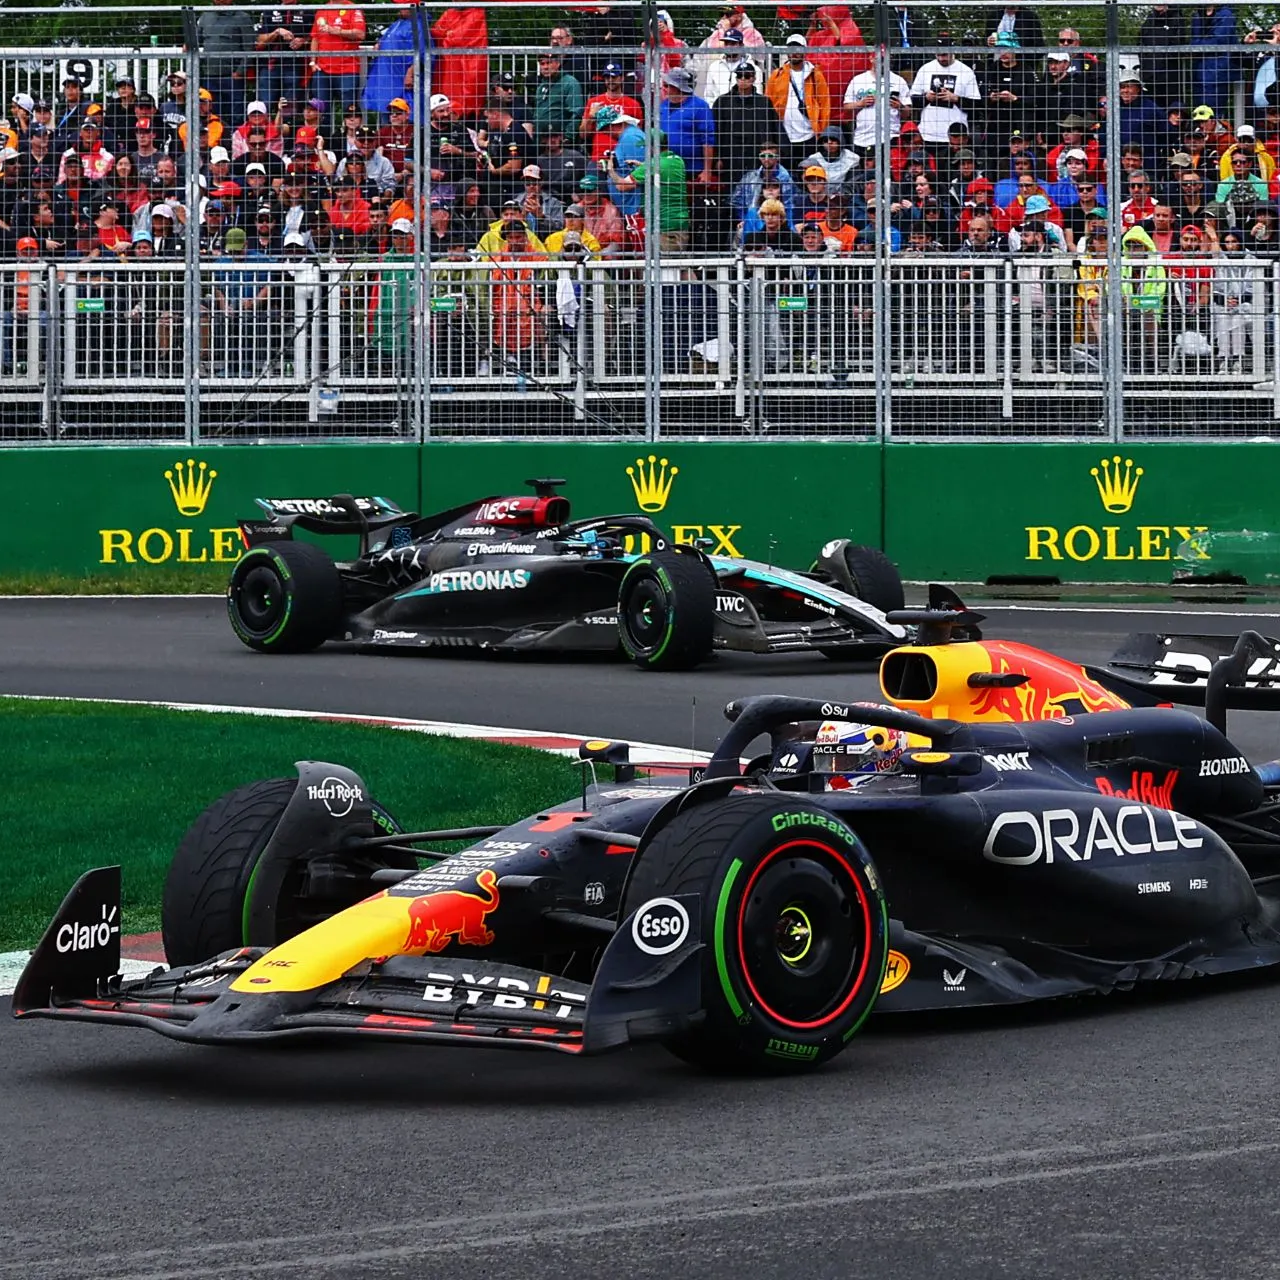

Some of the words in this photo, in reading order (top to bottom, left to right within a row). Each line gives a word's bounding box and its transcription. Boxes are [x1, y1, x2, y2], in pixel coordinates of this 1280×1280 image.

[66, 58, 94, 89] 9
[99, 527, 243, 564] ROLE
[1026, 525, 1210, 561] ROLEX
[429, 568, 528, 592] PETRONAS
[714, 596, 745, 613] IWC
[982, 751, 1033, 772] ROKT
[1198, 756, 1251, 777] HONDA
[983, 805, 1204, 866] ORACLE
[1137, 881, 1171, 895] SIEMENS
[55, 918, 110, 954] Claro
[422, 972, 588, 1018] BYBIT
